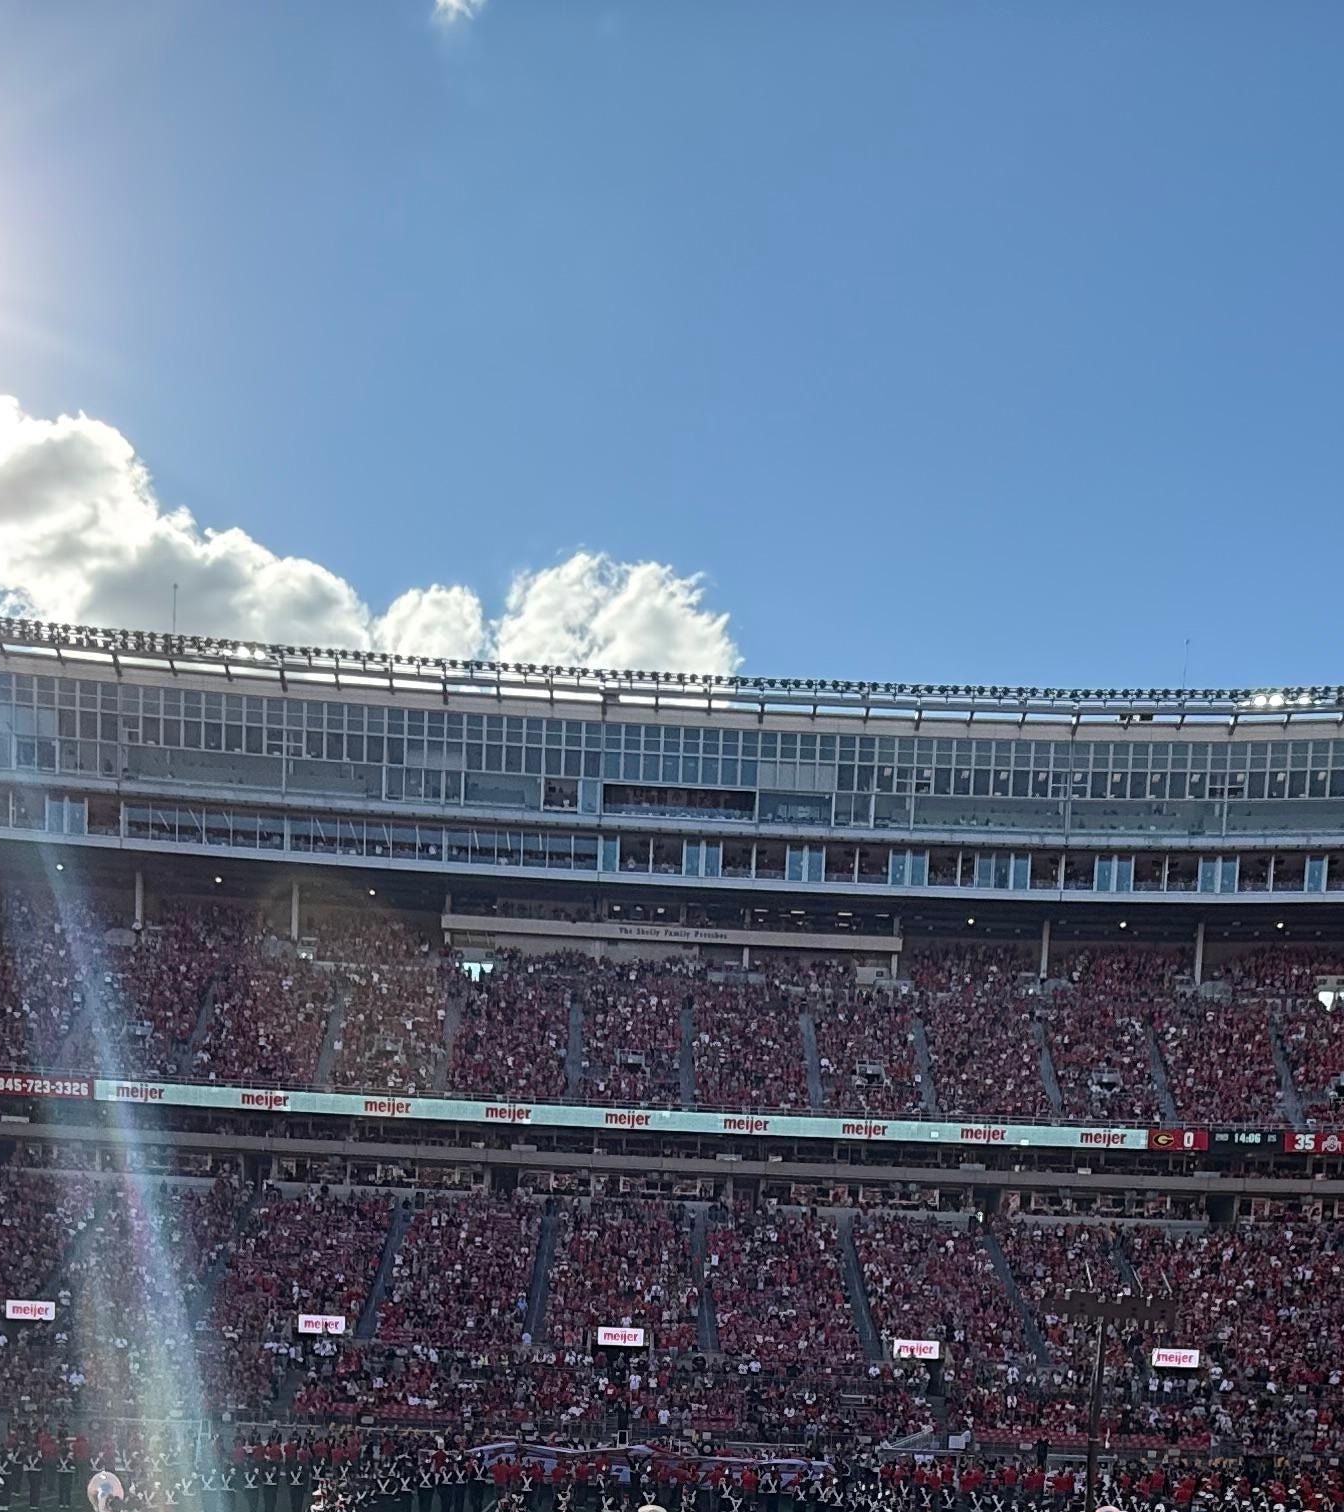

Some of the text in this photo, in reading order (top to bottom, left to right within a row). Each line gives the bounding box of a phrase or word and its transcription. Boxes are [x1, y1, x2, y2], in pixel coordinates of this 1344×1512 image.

[116, 1083, 164, 1102] meijer
[241, 1090, 290, 1110] meijer
[364, 1097, 411, 1116] meijer
[485, 1104, 532, 1123] meijer
[605, 1110, 652, 1128] meijer
[723, 1116, 770, 1134] meijer
[841, 1120, 888, 1138] meijer
[960, 1125, 1007, 1143] meijer
[1080, 1130, 1127, 1147] meijer
[1183, 1131, 1195, 1148] 0
[1294, 1133, 1316, 1150] 35
[12, 1303, 50, 1319] meijer
[603, 1328, 639, 1345] meijer
[1157, 1350, 1194, 1366] meijer
